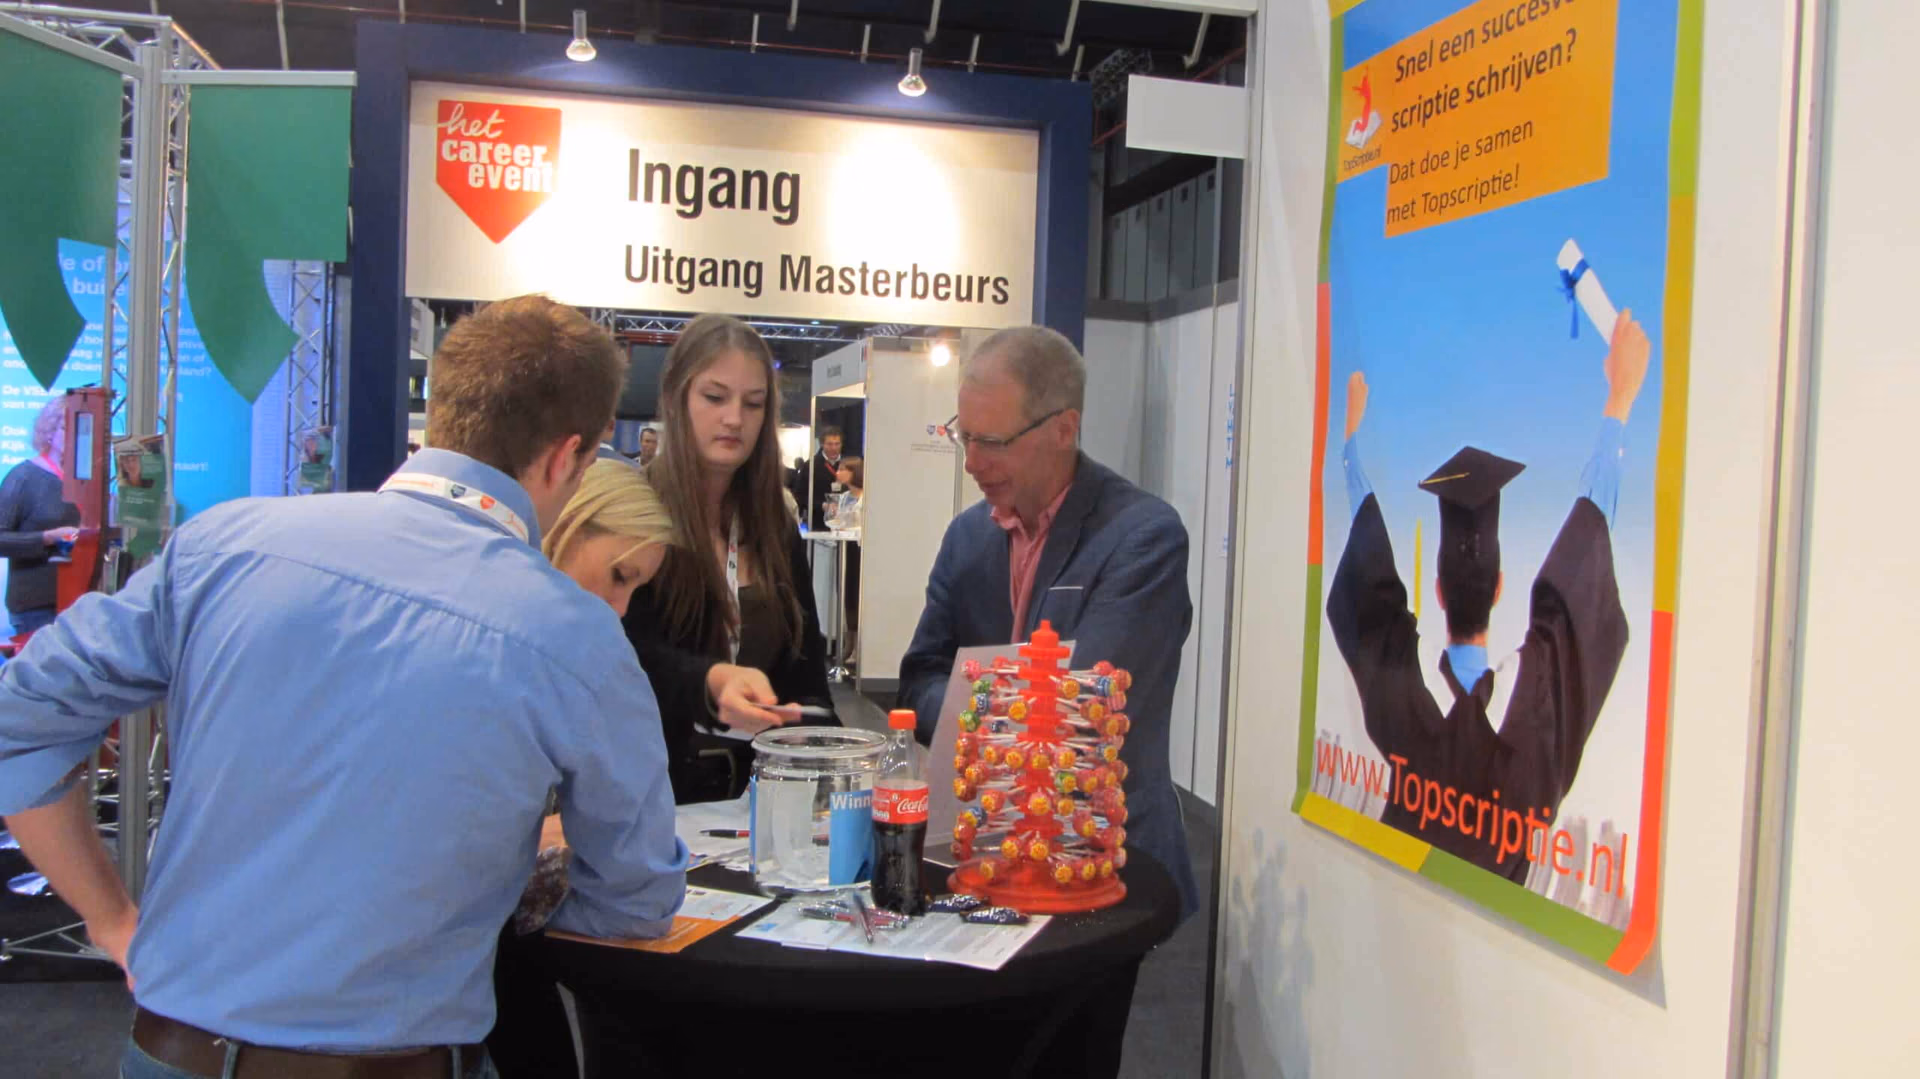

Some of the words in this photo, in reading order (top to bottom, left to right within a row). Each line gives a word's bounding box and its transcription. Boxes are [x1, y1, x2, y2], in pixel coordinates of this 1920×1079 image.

[1394, 38, 1434, 84] Snel
[1438, 28, 1476, 64] een
[1481, 0, 1575, 45] succes
[1391, 83, 1460, 133] scriptie
[1466, 27, 1577, 106] schrijven?
[437, 103, 505, 139] het
[441, 138, 547, 168] career
[1390, 161, 1416, 185] Dat
[1420, 149, 1450, 175] doe
[1453, 140, 1470, 170] je
[1475, 120, 1534, 157] samen
[468, 162, 554, 193] event
[628, 148, 800, 226] Ingang
[1386, 199, 1416, 226] met
[1421, 162, 1520, 217] Topscriptie!
[624, 244, 763, 298] Uitgang
[779, 253, 1009, 305] Masterbeurs
[1316, 738, 1628, 900] www.Topscriptie.nl
